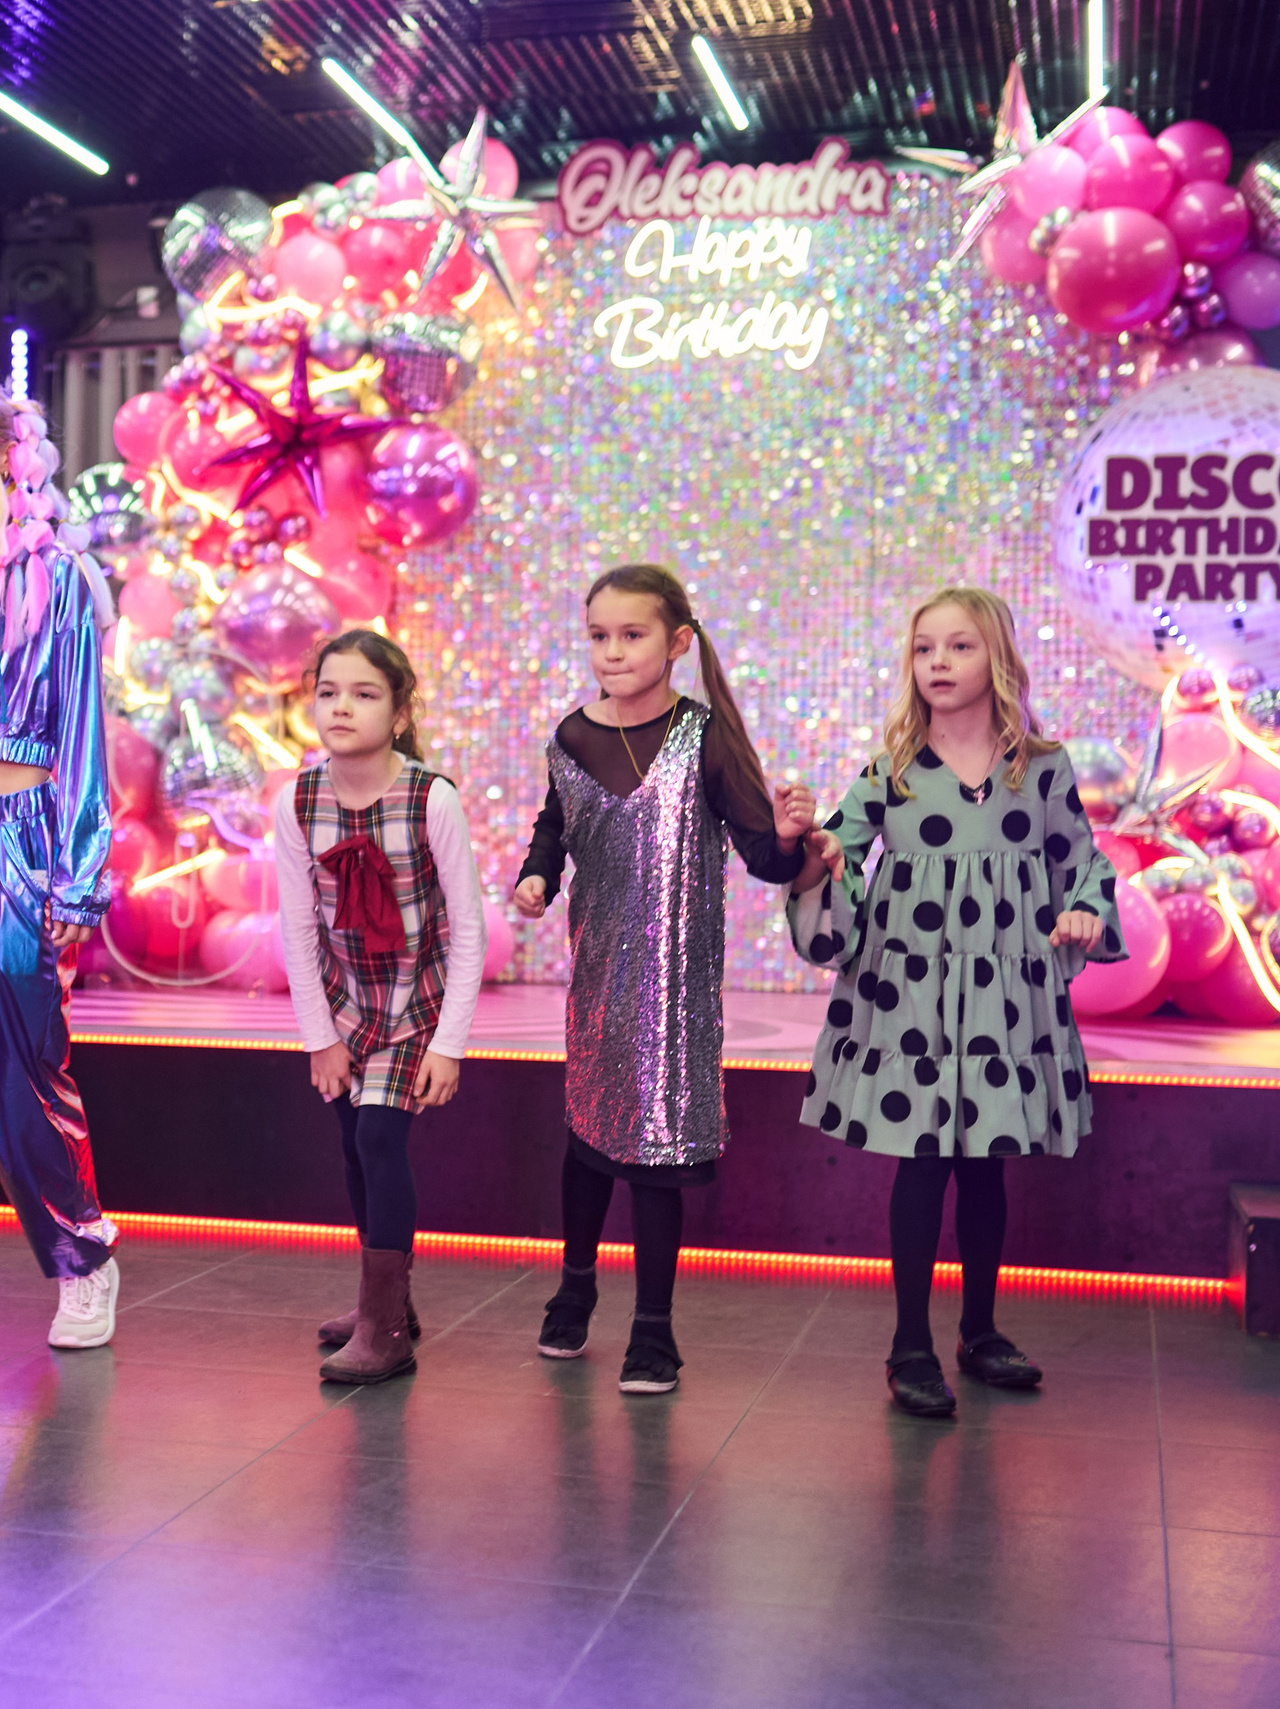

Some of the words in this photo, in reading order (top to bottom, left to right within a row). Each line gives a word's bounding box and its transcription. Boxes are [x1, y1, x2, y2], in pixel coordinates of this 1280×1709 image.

[559, 136, 889, 235] Oleksandra
[624, 214, 813, 286] Happy
[593, 290, 829, 370] Birthday
[1105, 453, 1280, 511] DISC
[1088, 516, 1280, 557] BIRTHD
